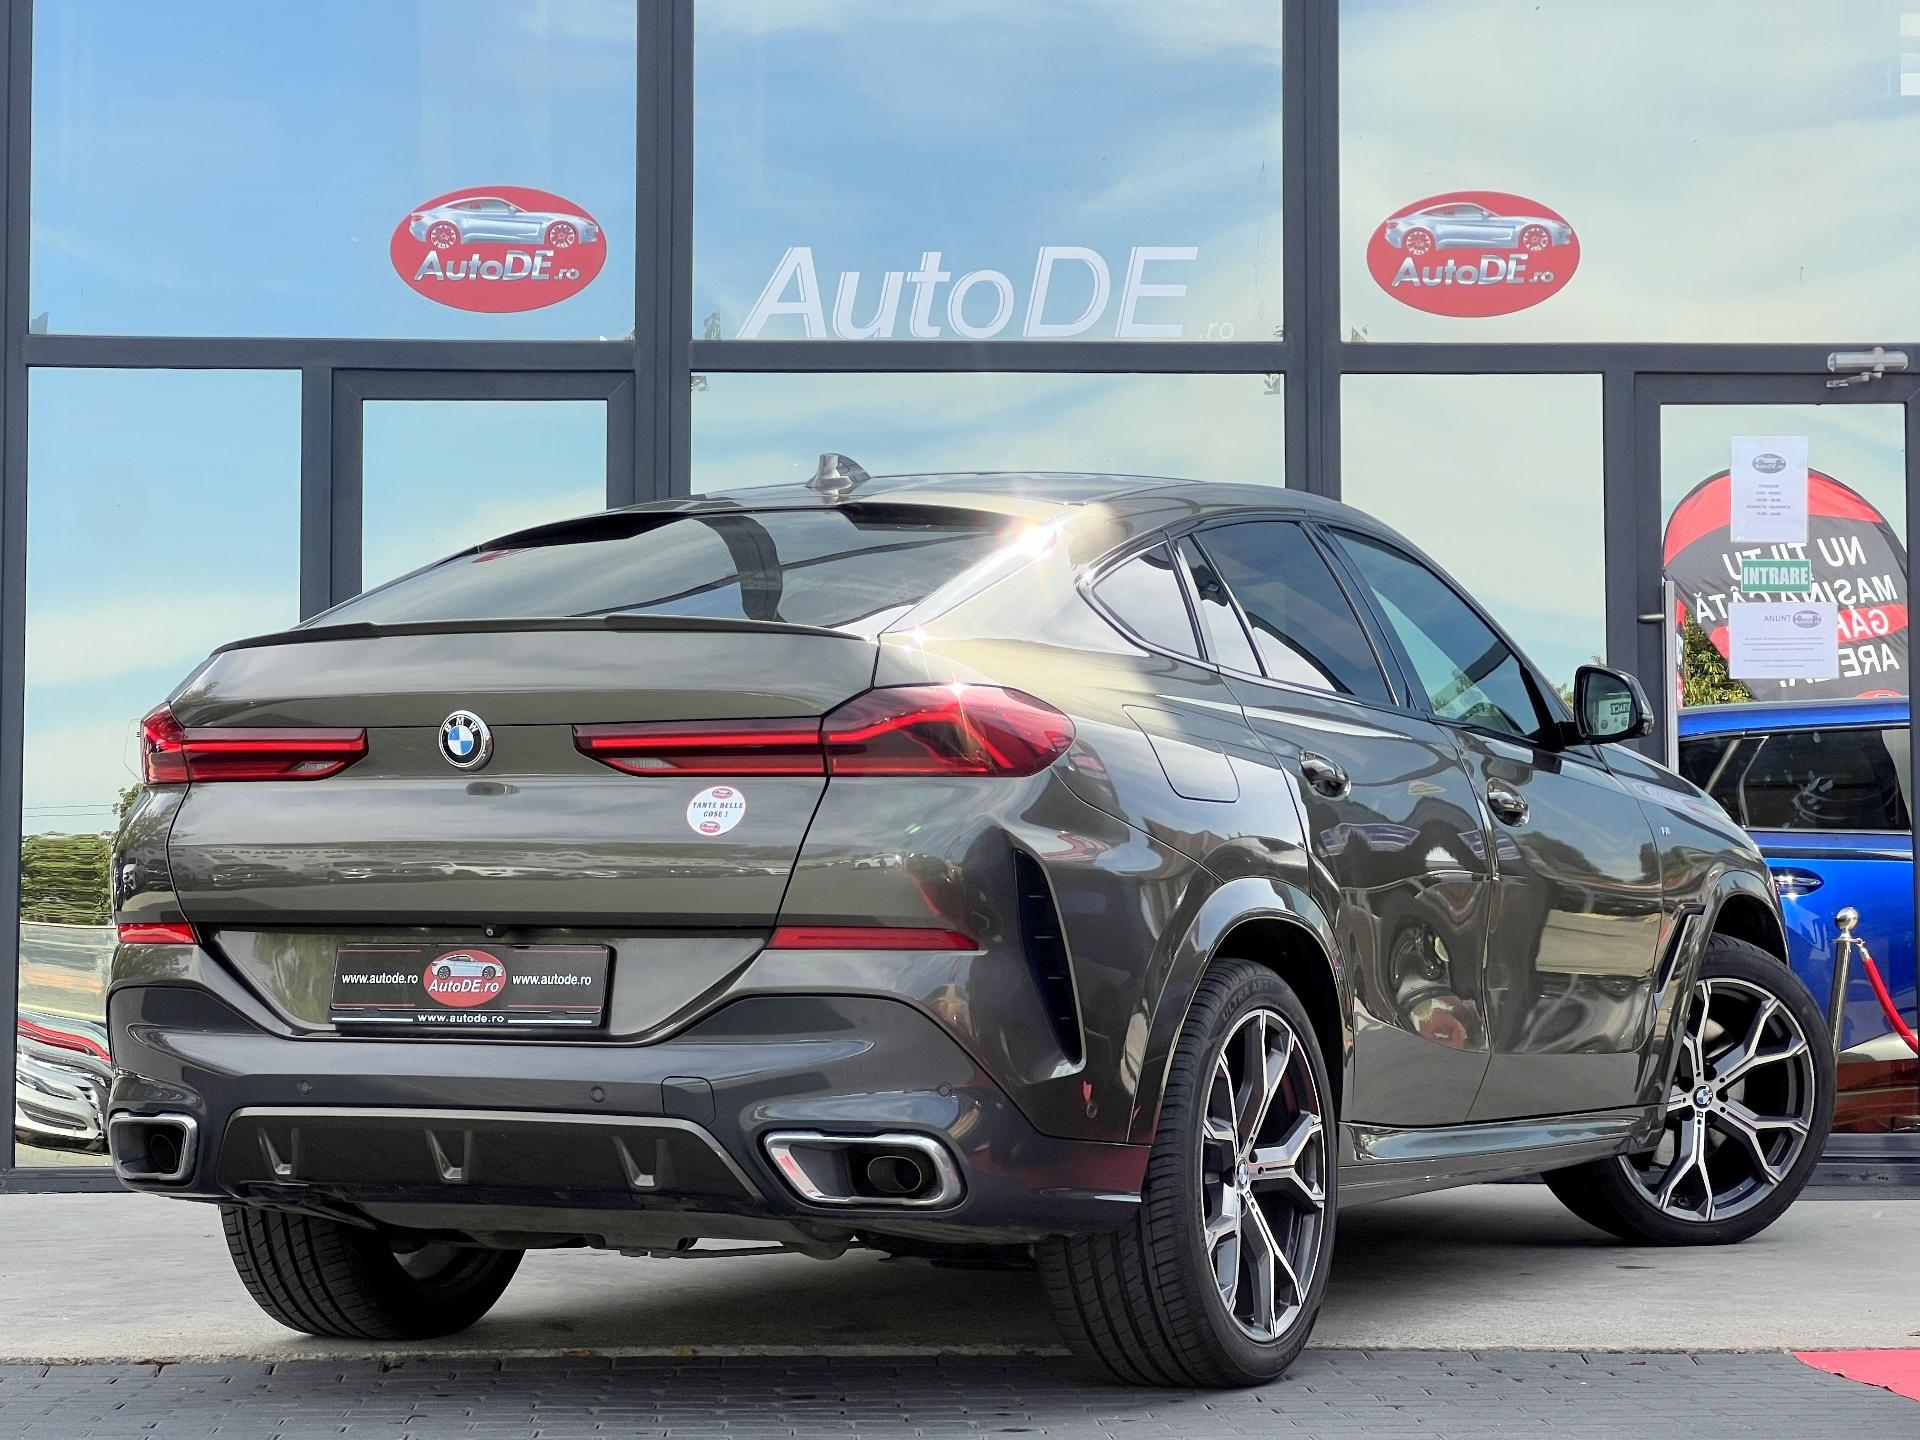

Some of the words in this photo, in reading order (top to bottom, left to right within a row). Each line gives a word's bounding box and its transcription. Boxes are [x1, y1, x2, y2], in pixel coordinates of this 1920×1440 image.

[1743, 566, 1809, 585] INTRARE
[341, 971, 419, 985] www.autode.ro
[512, 973, 592, 986] www.autode.ro
[428, 979, 500, 993] AutoDE.ro
[417, 1012, 505, 1024] www.autode.ro
